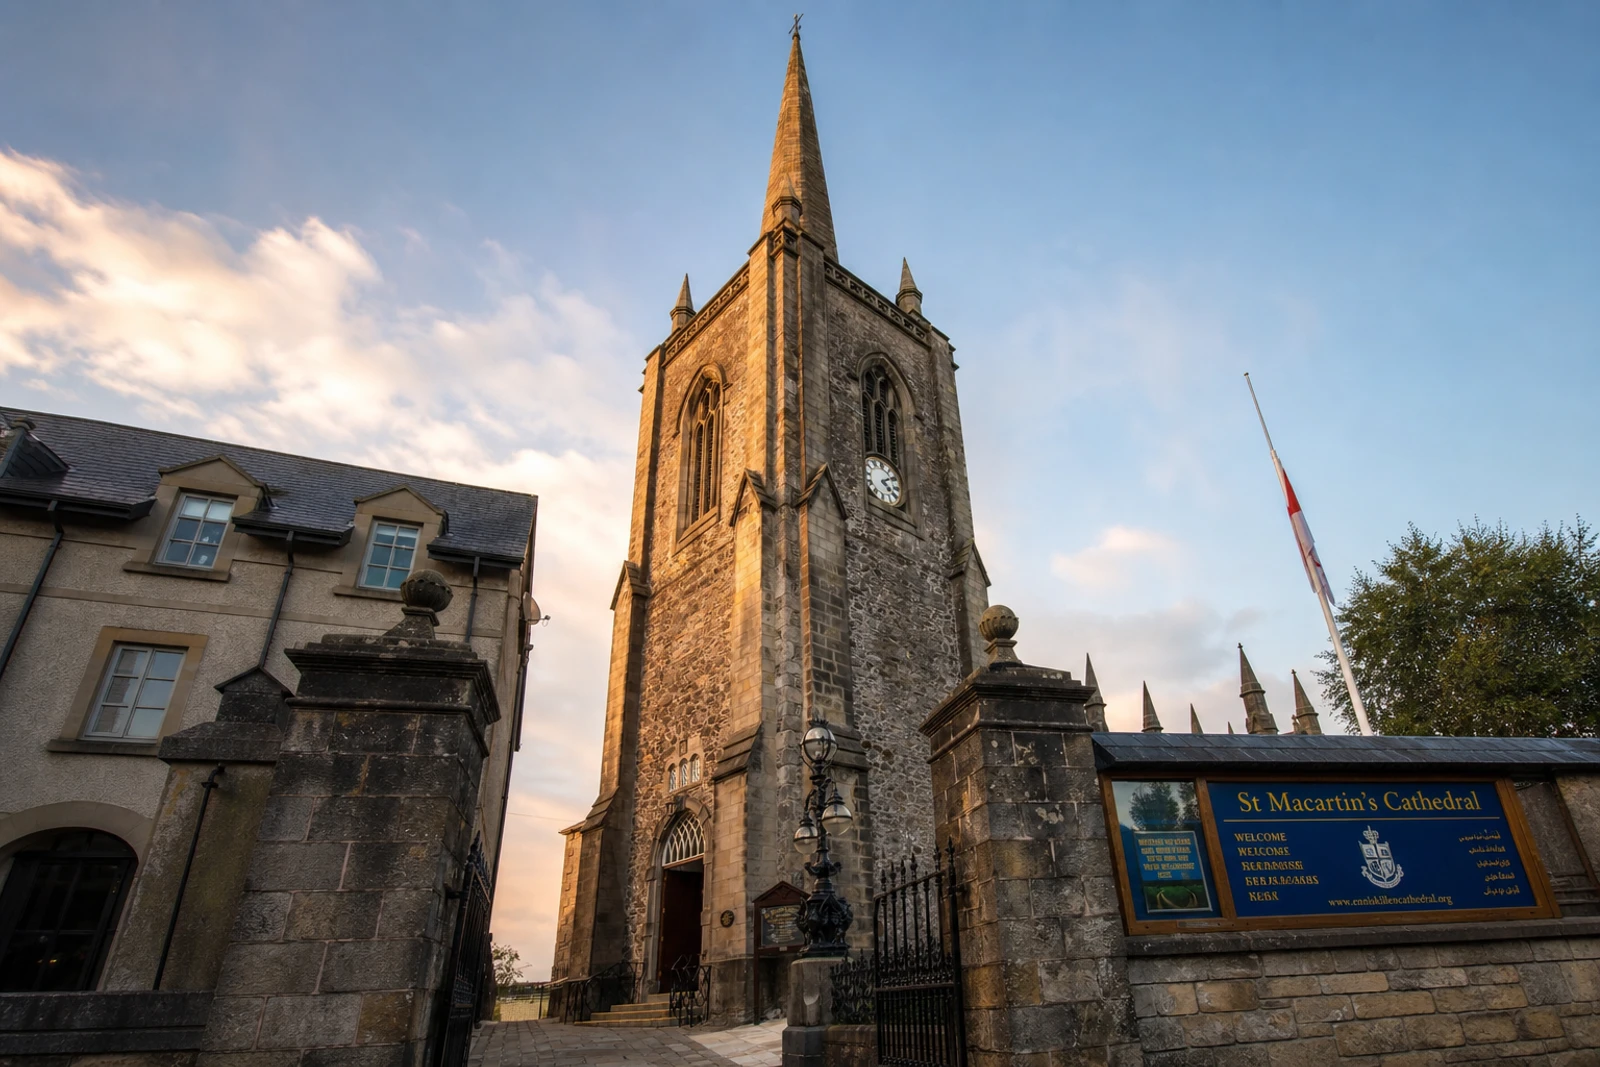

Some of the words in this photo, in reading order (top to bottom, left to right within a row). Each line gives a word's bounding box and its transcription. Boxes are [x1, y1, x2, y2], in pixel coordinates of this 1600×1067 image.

[1237, 791, 1263, 813] St
[1265, 791, 1378, 812] Macartin's
[1383, 790, 1483, 812] Cathedral
[1233, 832, 1288, 842] WELCOME
